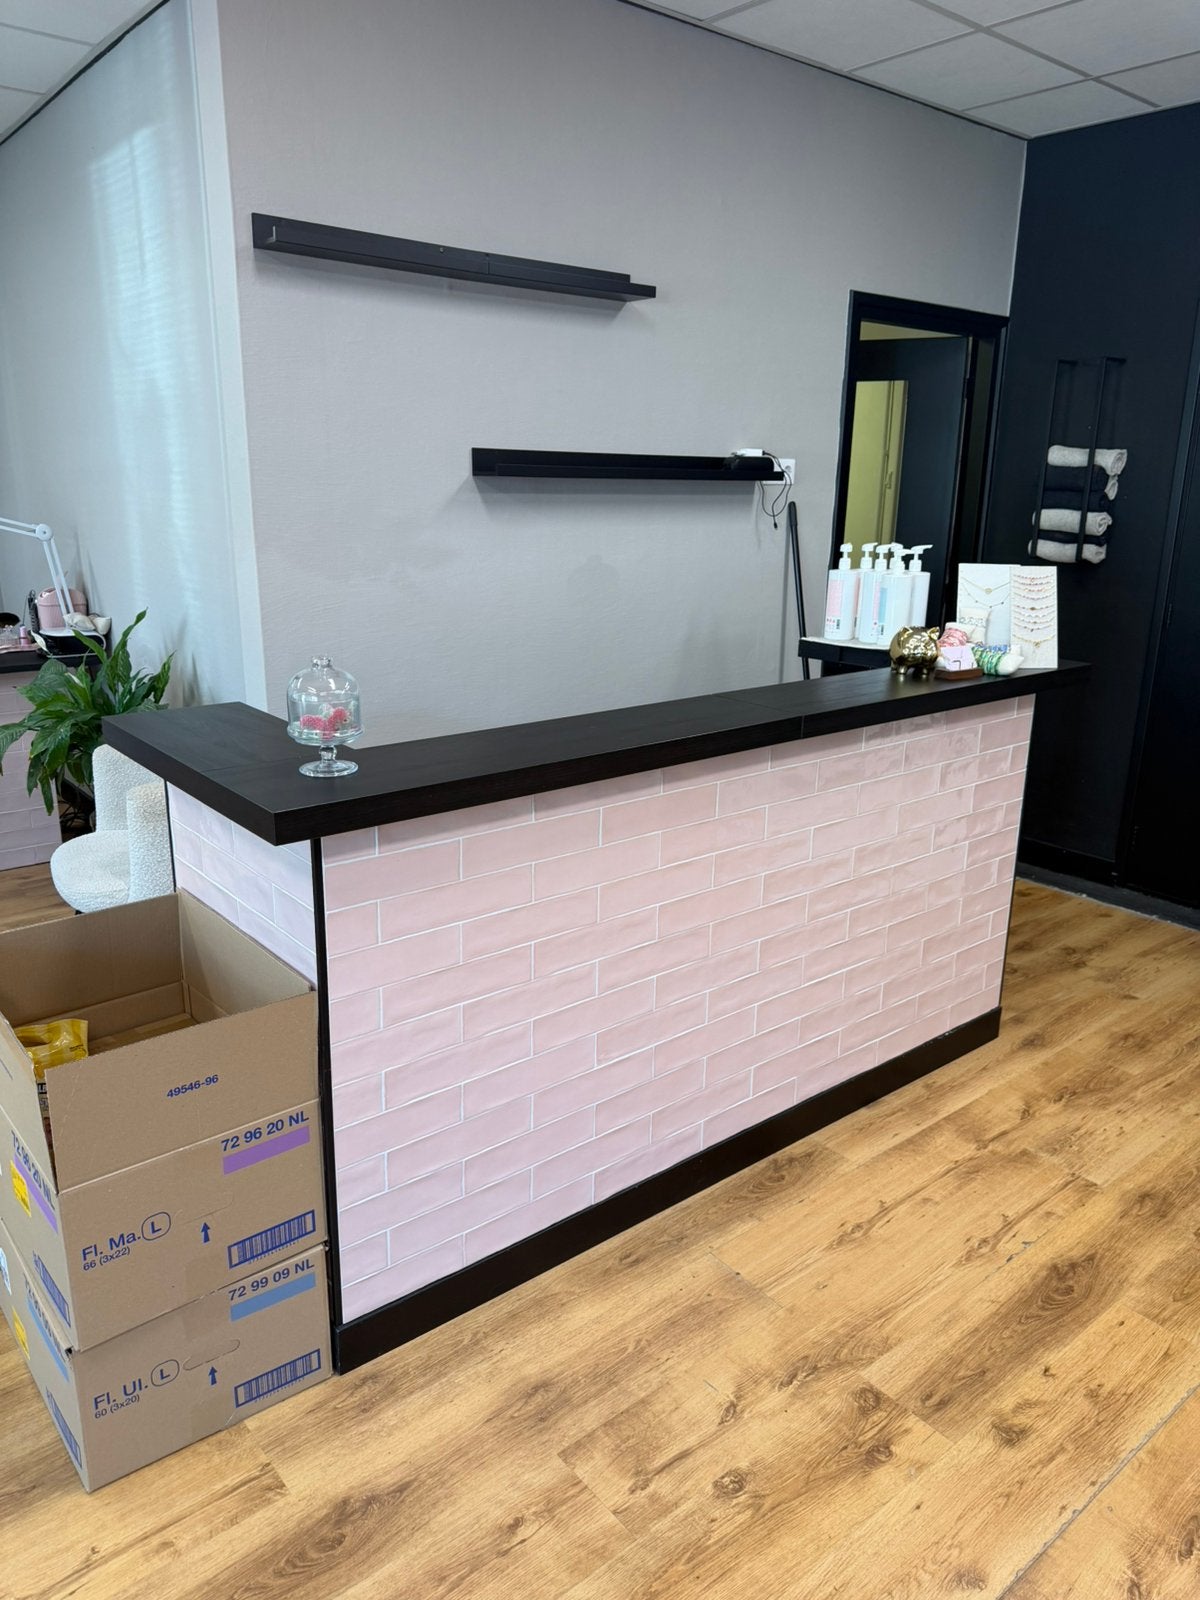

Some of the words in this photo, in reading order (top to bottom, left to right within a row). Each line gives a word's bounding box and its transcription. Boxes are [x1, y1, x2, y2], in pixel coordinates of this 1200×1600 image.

[166, 1074, 219, 1098] 49546-96
[221, 1135, 240, 1152] 72
[244, 1127, 262, 1143] 96
[266, 1119, 284, 1135] 20
[288, 1110, 310, 1126] NL
[82, 1244, 103, 1261] Fl.
[108, 1232, 141, 1250] Ma.
[83, 1260, 97, 1271] 66
[99, 1246, 130, 1266] (3x22)
[228, 1285, 247, 1301] 72
[250, 1276, 268, 1292] 99
[273, 1267, 290, 1282] 09
[294, 1259, 315, 1274] NL
[93, 1392, 116, 1410] Fl.
[94, 1408, 108, 1419] 60
[110, 1394, 140, 1413] (3x20)
